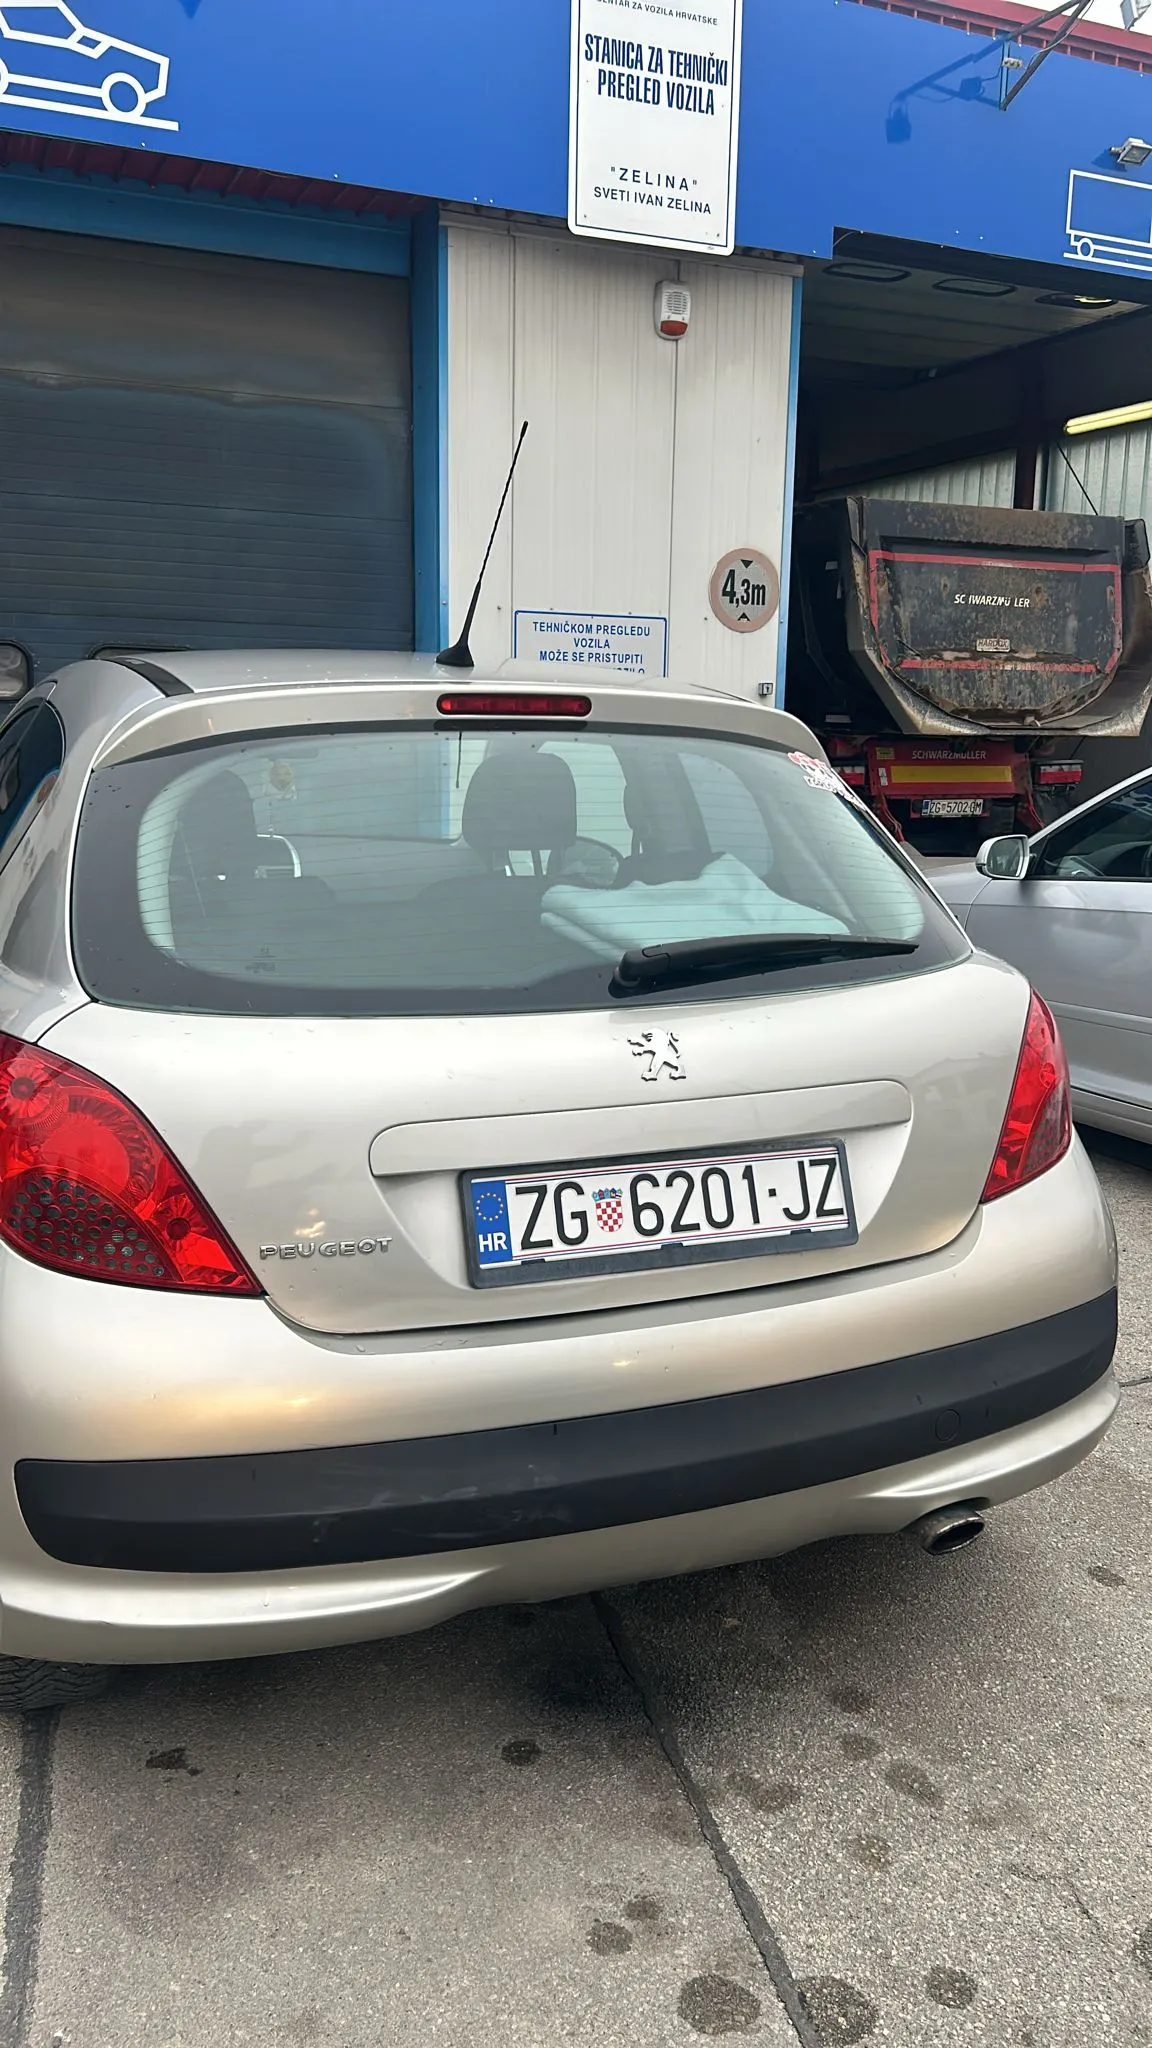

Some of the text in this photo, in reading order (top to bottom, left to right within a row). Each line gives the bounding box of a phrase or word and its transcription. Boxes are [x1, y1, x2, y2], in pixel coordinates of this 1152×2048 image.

[597, 0, 718, 26] NTAR ZA VOZILA HRVATSKE
[585, 33, 728, 86] STANICA ZA TEHNIČKI
[598, 69, 715, 115] PREGLED VOZILA
[594, 187, 712, 215] SVETI IVAN ZELINA
[721, 569, 767, 608] 4,3m
[533, 621, 650, 637] TEHNIČKOM PREGLEDU
[573, 637, 610, 649] VOZILA
[539, 650, 643, 664] MOŽE SE PRISTUPITI
[516, 1181, 589, 1250] ZG
[259, 1236, 393, 1260] PEUGEOT
[478, 1232, 508, 1252] HR
